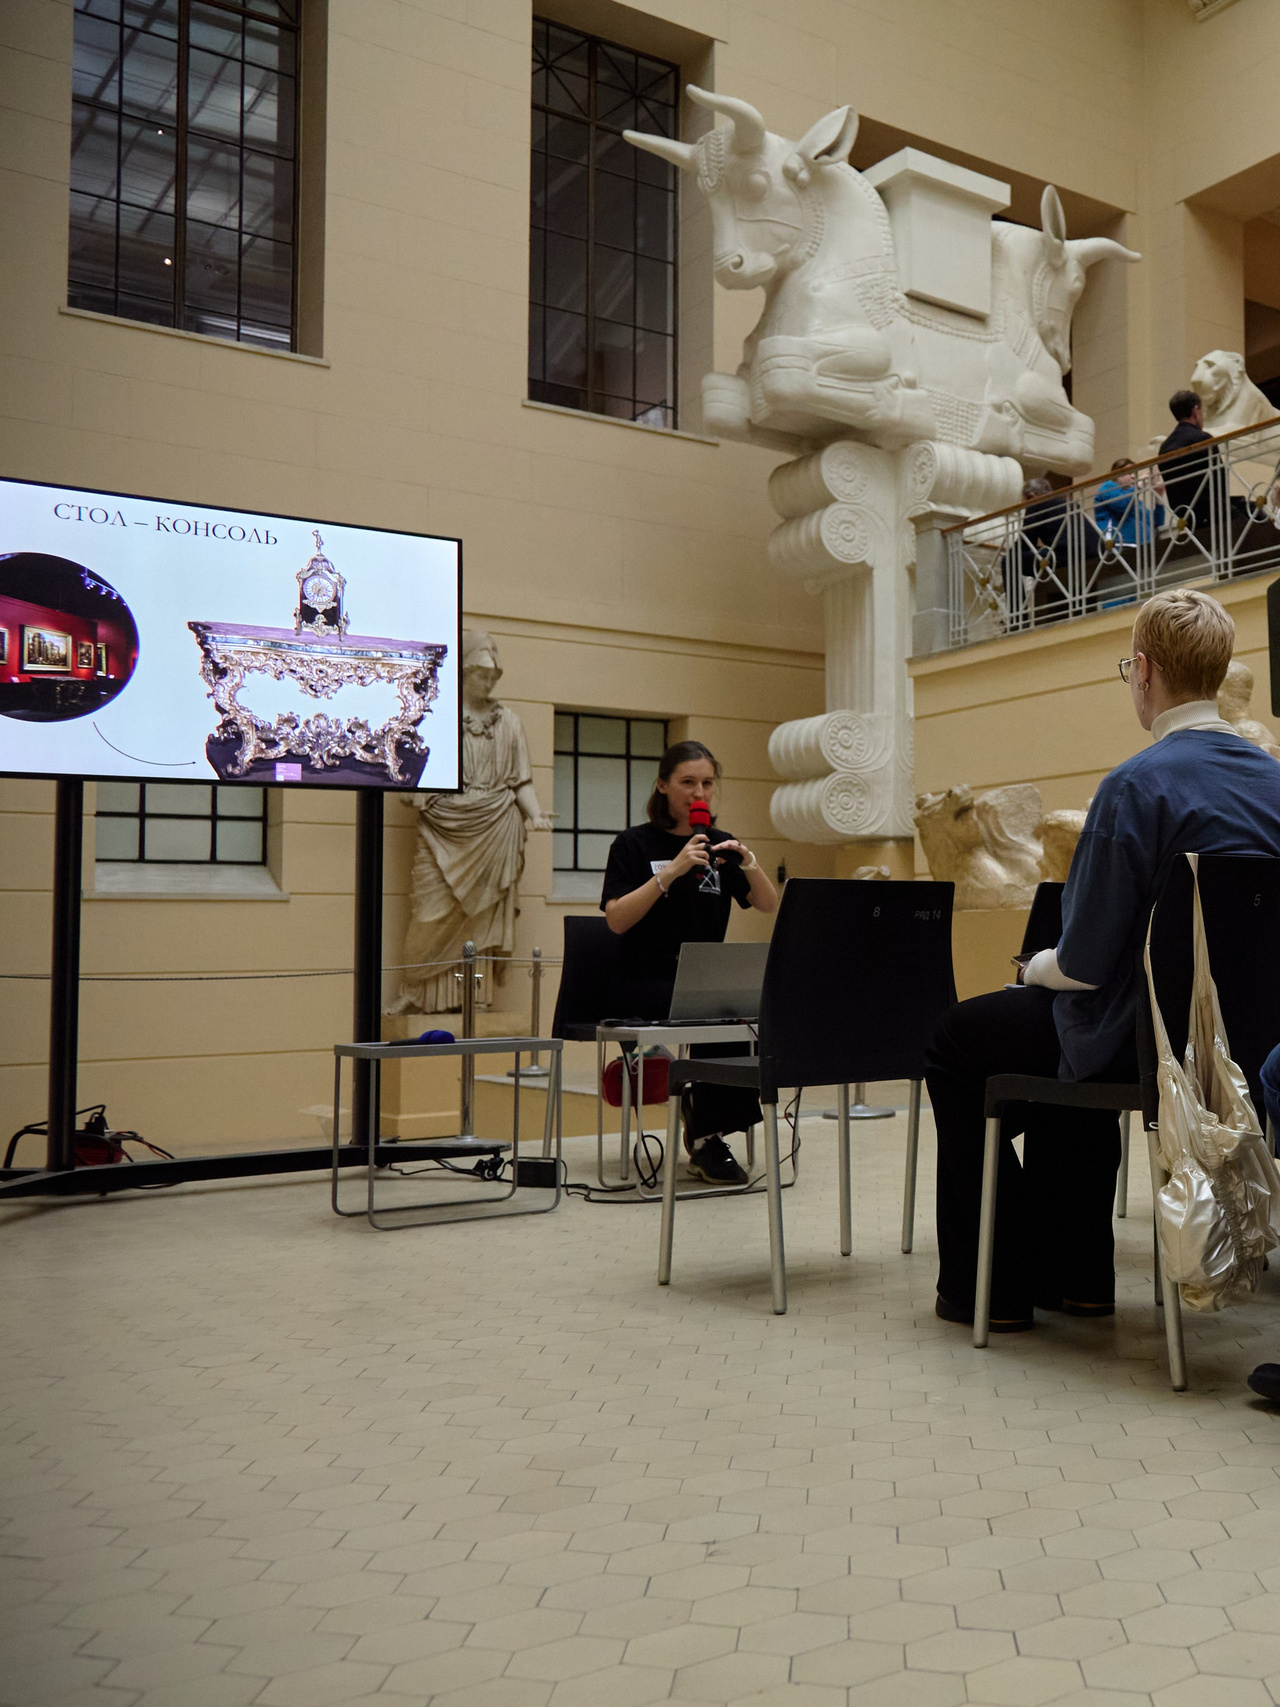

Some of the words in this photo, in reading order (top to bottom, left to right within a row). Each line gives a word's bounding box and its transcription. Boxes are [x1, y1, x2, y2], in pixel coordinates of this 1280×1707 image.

[54, 503, 128, 527] СТОЛ
[155, 515, 278, 545] КОНСОЛЬ
[1253, 893, 1262, 907] 5
[872, 906, 881, 917] 8
